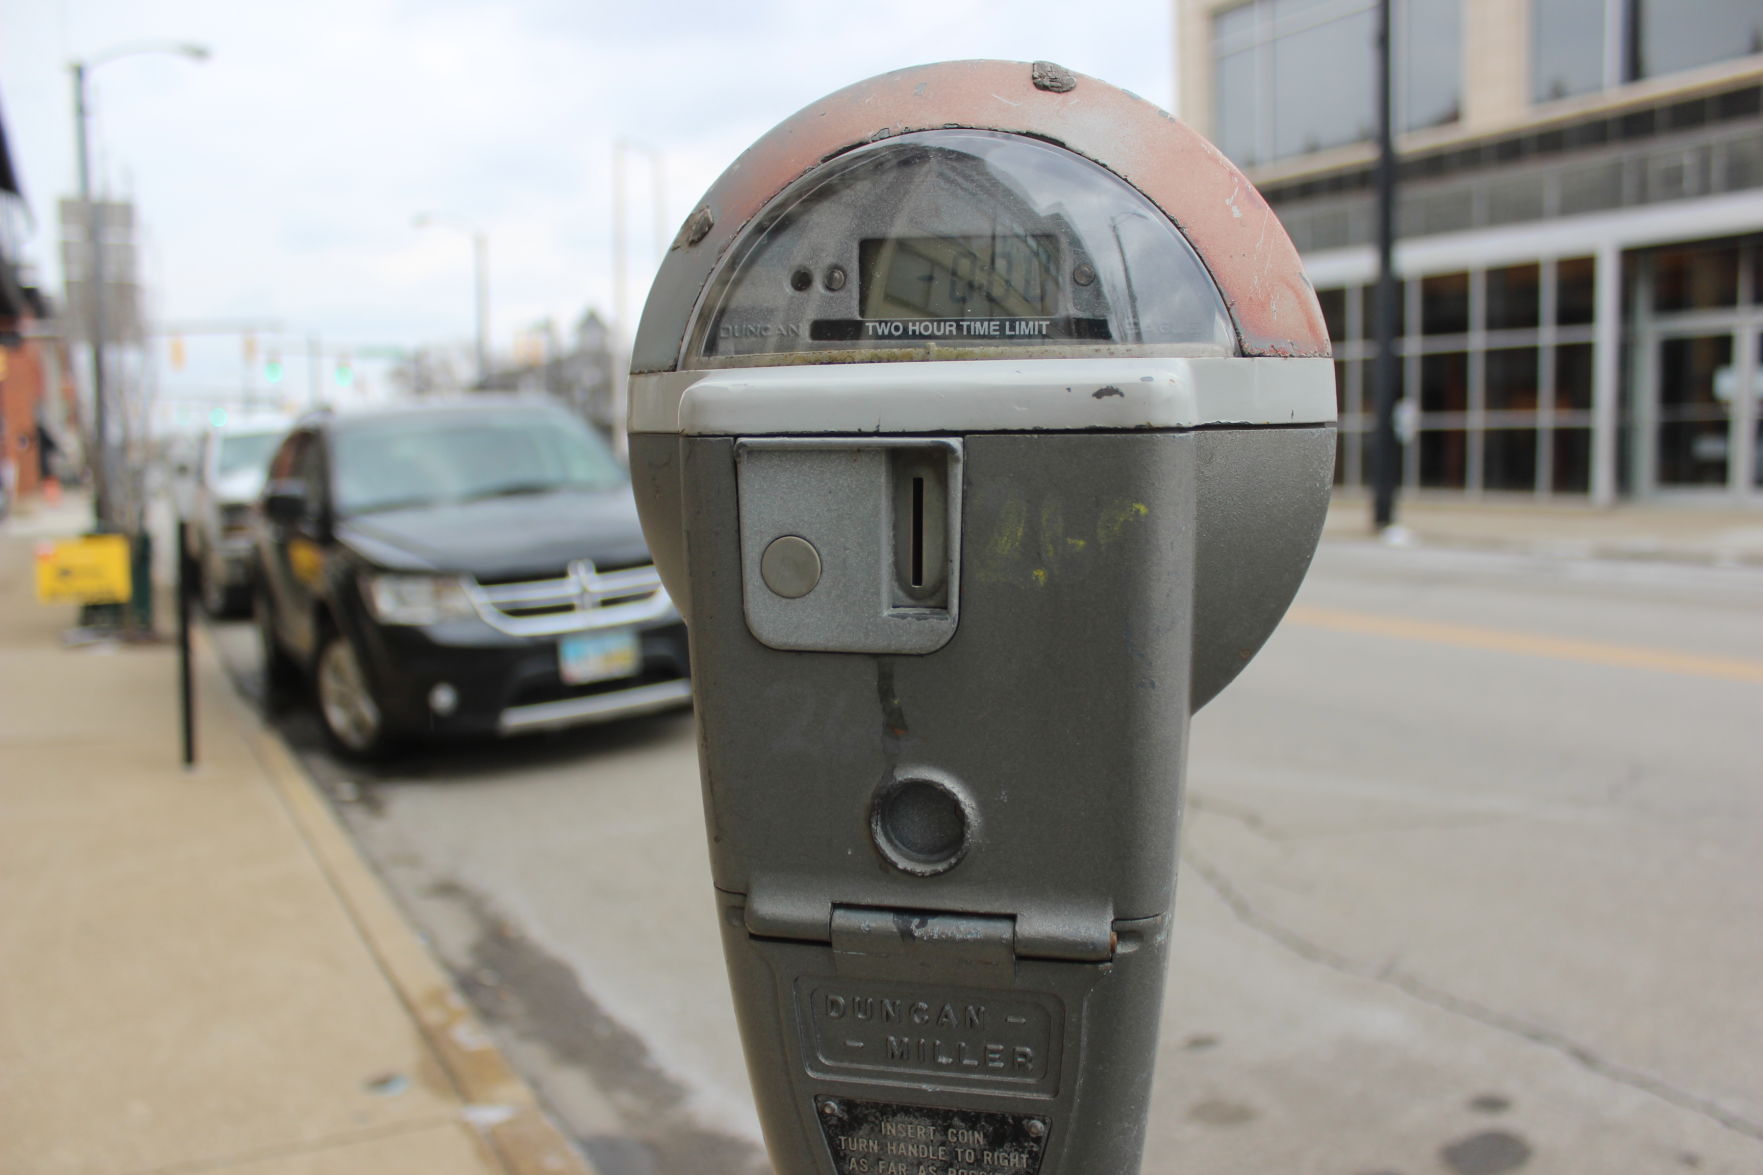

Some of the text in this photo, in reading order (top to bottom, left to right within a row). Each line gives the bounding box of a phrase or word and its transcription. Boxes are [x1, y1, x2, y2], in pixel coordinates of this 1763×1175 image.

[865, 320, 1051, 336] TWO HOUR TIME LIMIT
[825, 994, 986, 1030] DUNCAN
[886, 1036, 1034, 1070] MILLER
[881, 1121, 984, 1146] INSERT COIN
[839, 1135, 1029, 1168] TURN HANDLE TO RIGHT
[849, 1157, 869, 1172] AS
[879, 1160, 908, 1175] FAR
